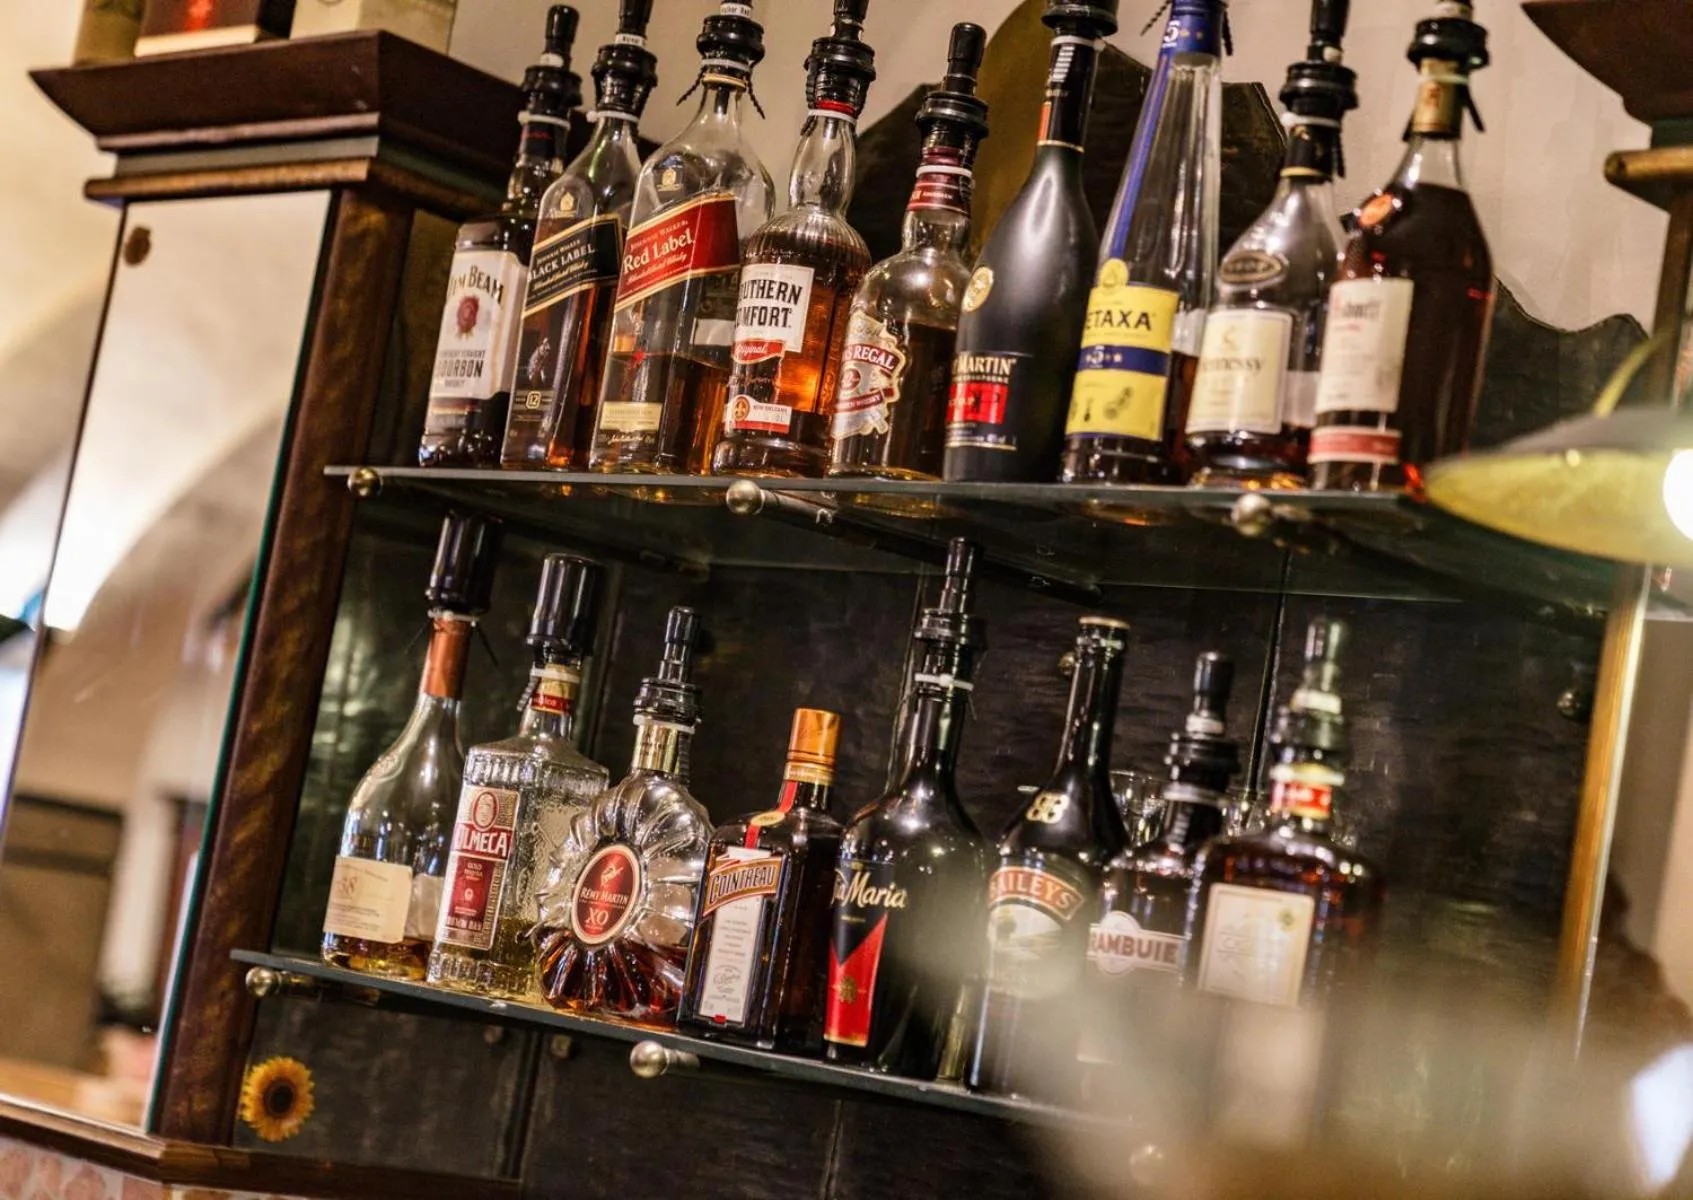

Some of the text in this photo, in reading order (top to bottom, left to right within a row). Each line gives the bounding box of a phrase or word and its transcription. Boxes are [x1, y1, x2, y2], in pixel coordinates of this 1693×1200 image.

[1164, 20, 1180, 42] 5
[561, 243, 596, 266] LABEL
[623, 248, 650, 275] Red
[653, 228, 693, 260] Label
[467, 264, 504, 304] BEAM
[739, 279, 803, 305] UTHERN
[735, 305, 790, 329] MFORT
[1086, 309, 1152, 332] ETAXA
[853, 344, 896, 371] REGAL
[957, 352, 1011, 376] MARTIN
[709, 864, 775, 904] COINTREAU
[841, 870, 908, 909] Maria
[601, 889, 629, 905] MARTIN
[585, 907, 609, 926] XO
[1091, 930, 1179, 964] AMBUIE
